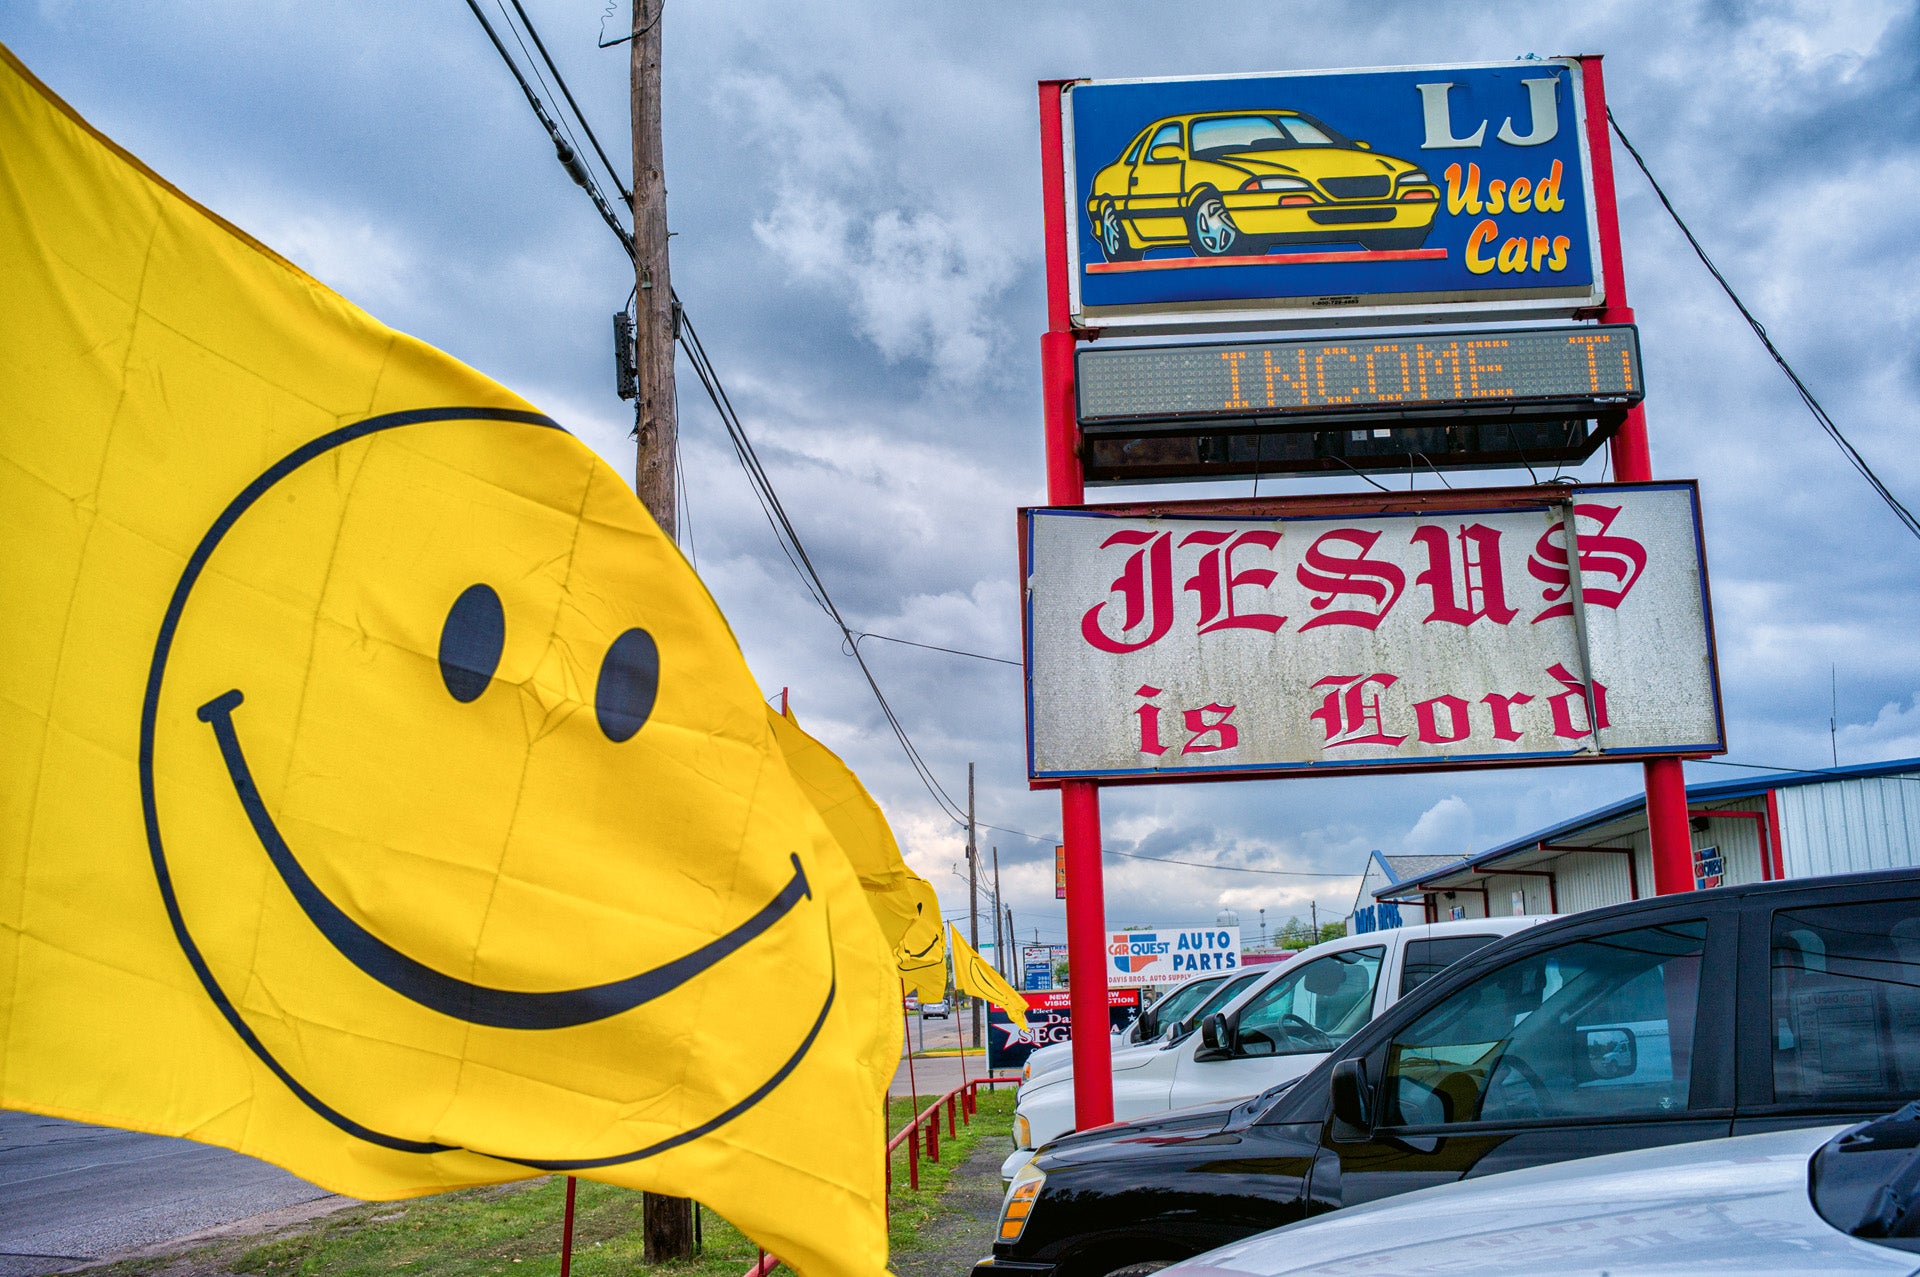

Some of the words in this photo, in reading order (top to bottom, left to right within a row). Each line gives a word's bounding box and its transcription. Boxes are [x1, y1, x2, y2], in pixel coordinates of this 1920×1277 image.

[1416, 77, 1560, 149] LJ
[1444, 158, 1566, 216] Used
[1465, 219, 1571, 275] Cars
[1221, 339, 1514, 408] INCOME
[1081, 504, 1648, 655] JESUS
[1134, 685, 1240, 757] is
[1310, 663, 1612, 750] Lord
[1173, 952, 1236, 972] PARTS
[1177, 931, 1231, 951] AUTO
[1168, 973, 1191, 981] SUPPLY
